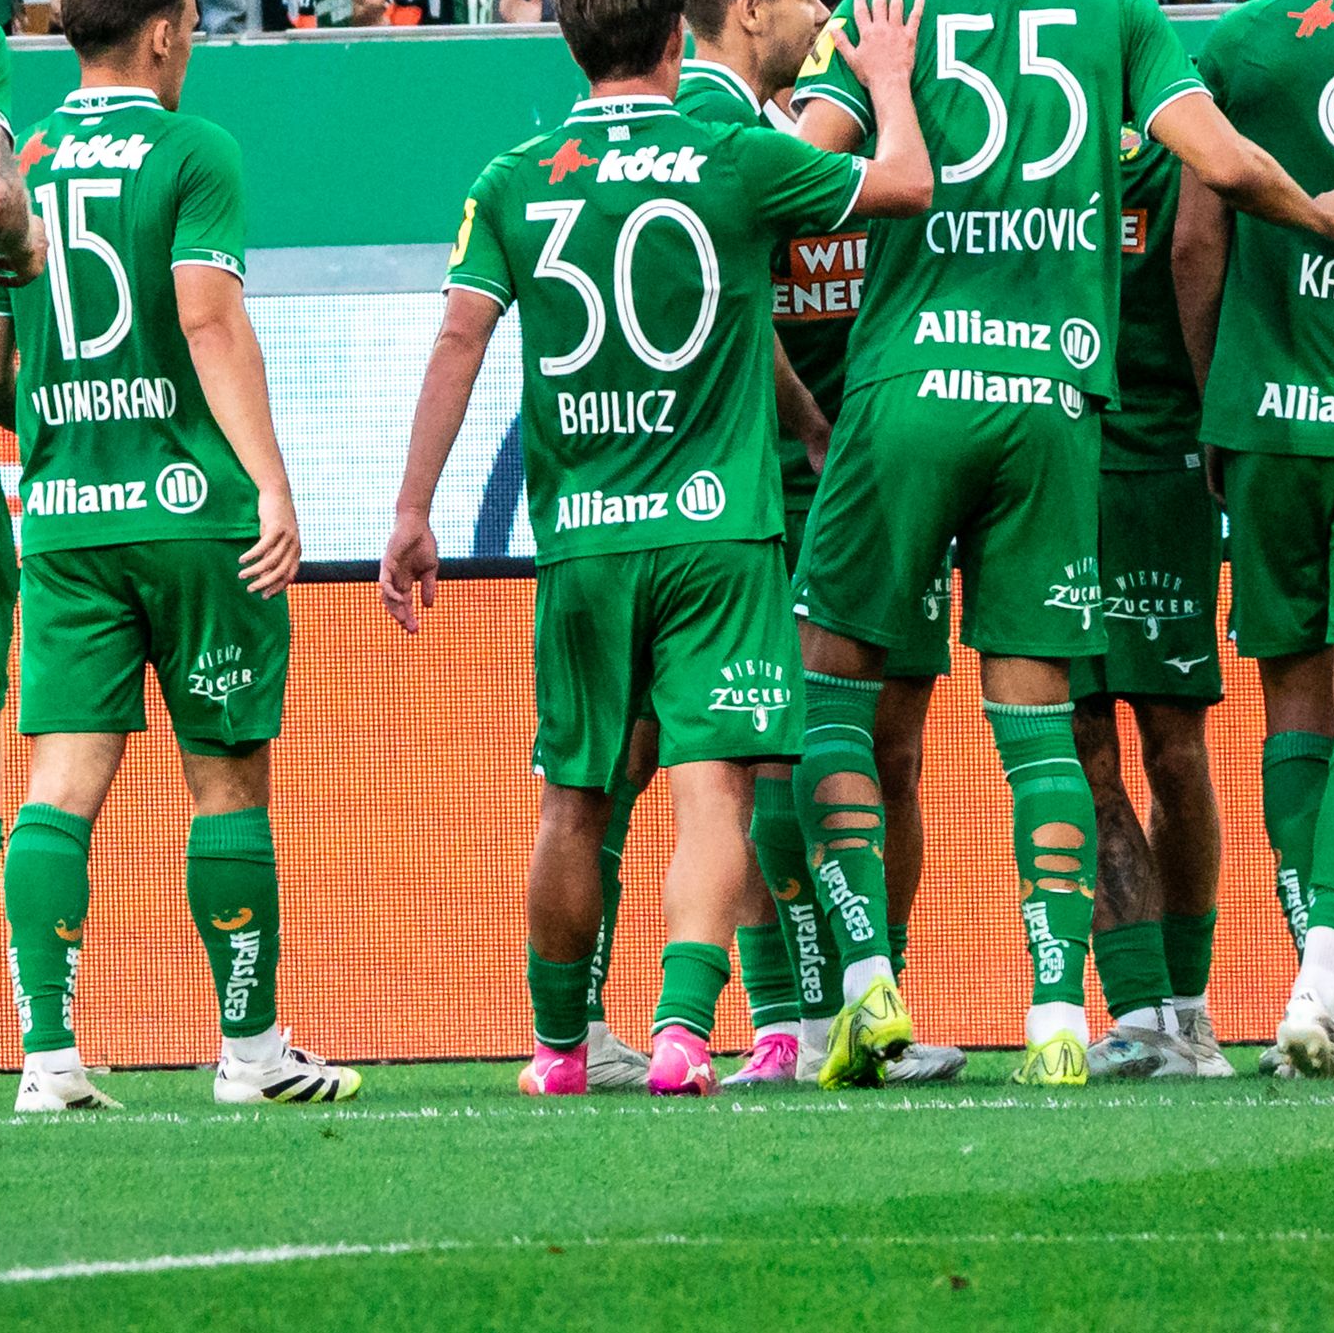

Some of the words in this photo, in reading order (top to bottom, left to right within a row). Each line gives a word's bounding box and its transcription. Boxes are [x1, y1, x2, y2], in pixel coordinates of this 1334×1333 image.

[79, 96, 109, 110] SCR
[601, 104, 634, 116] SCR
[935, 9, 1090, 184] 55
[596, 145, 709, 183] köck
[926, 193, 1101, 254] CVETKOVIĆ
[34, 178, 134, 361] 15
[523, 197, 722, 376] 30
[913, 309, 1052, 352] Allianz
[917, 368, 1054, 405] Allianz
[557, 390, 677, 435] BAJLICZ
[26, 479, 148, 516] Allianz
[555, 490, 669, 534] Allianz
[1115, 570, 1183, 592] WIENER
[1104, 597, 1195, 616] ZUCKER
[818, 858, 875, 943] easystaff
[788, 903, 826, 1004] easystaff
[1022, 900, 1071, 985] easystaff
[224, 929, 261, 1022] easystaff
